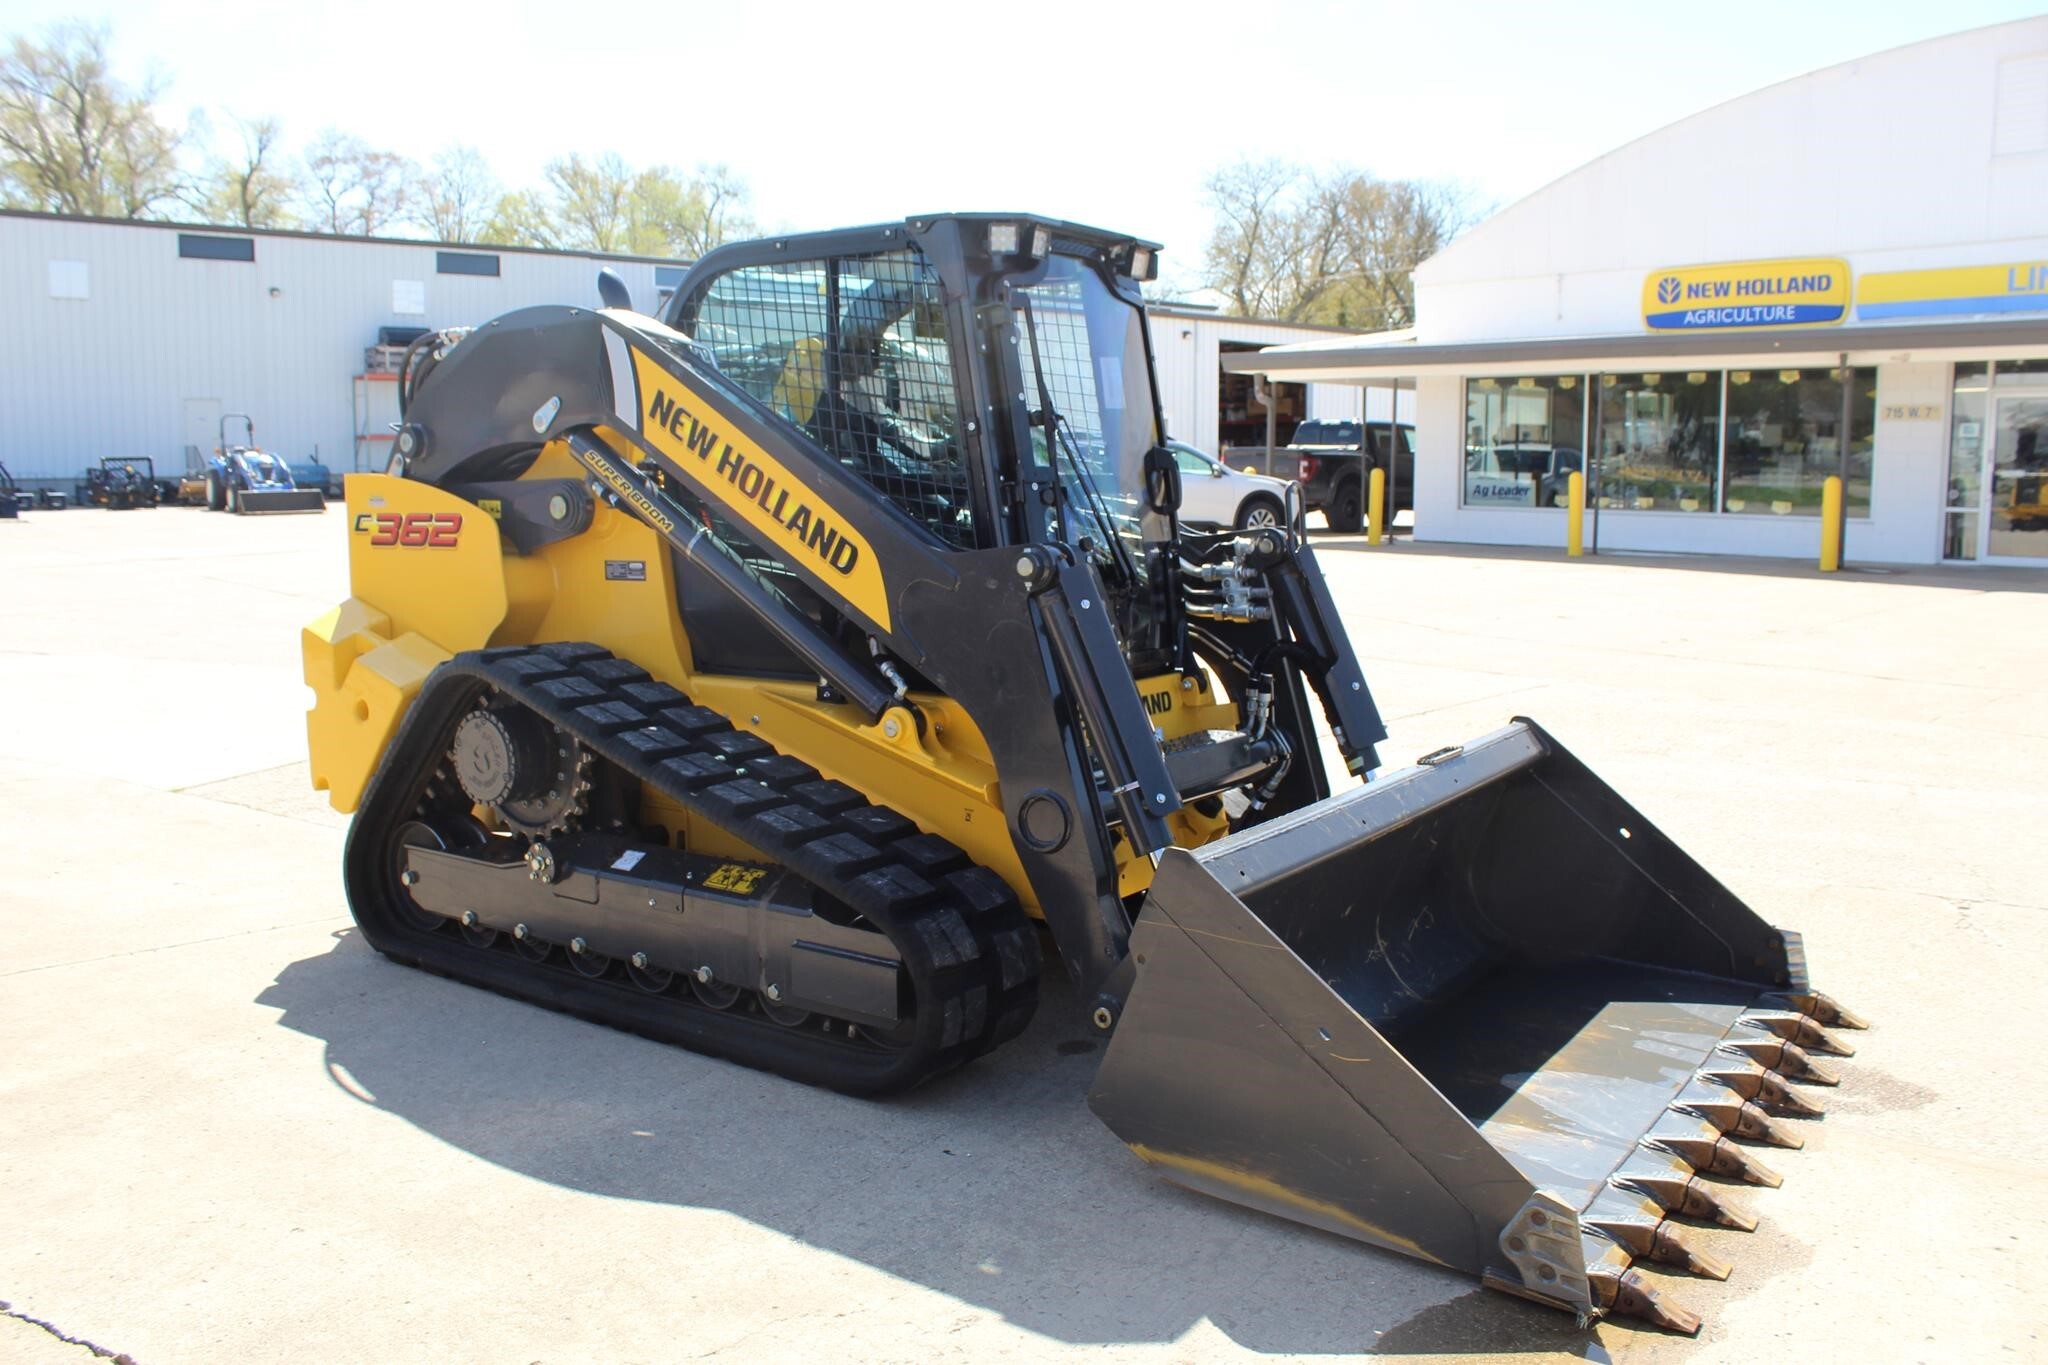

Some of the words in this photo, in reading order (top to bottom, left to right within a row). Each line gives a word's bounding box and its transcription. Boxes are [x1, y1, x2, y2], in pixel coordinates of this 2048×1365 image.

[1686, 281, 1732, 299] NEW
[1736, 274, 1833, 296] HOLLAND
[1683, 305, 1796, 325] AGRICULTURE
[1886, 406, 1905, 419] 715
[585, 449, 632, 495] SUPER
[630, 490, 675, 533] BOOM
[649, 389, 719, 461] NEW
[716, 443, 859, 575] HOLLAND
[1472, 484, 1490, 498] Ag
[1491, 484, 1531, 497] Leader
